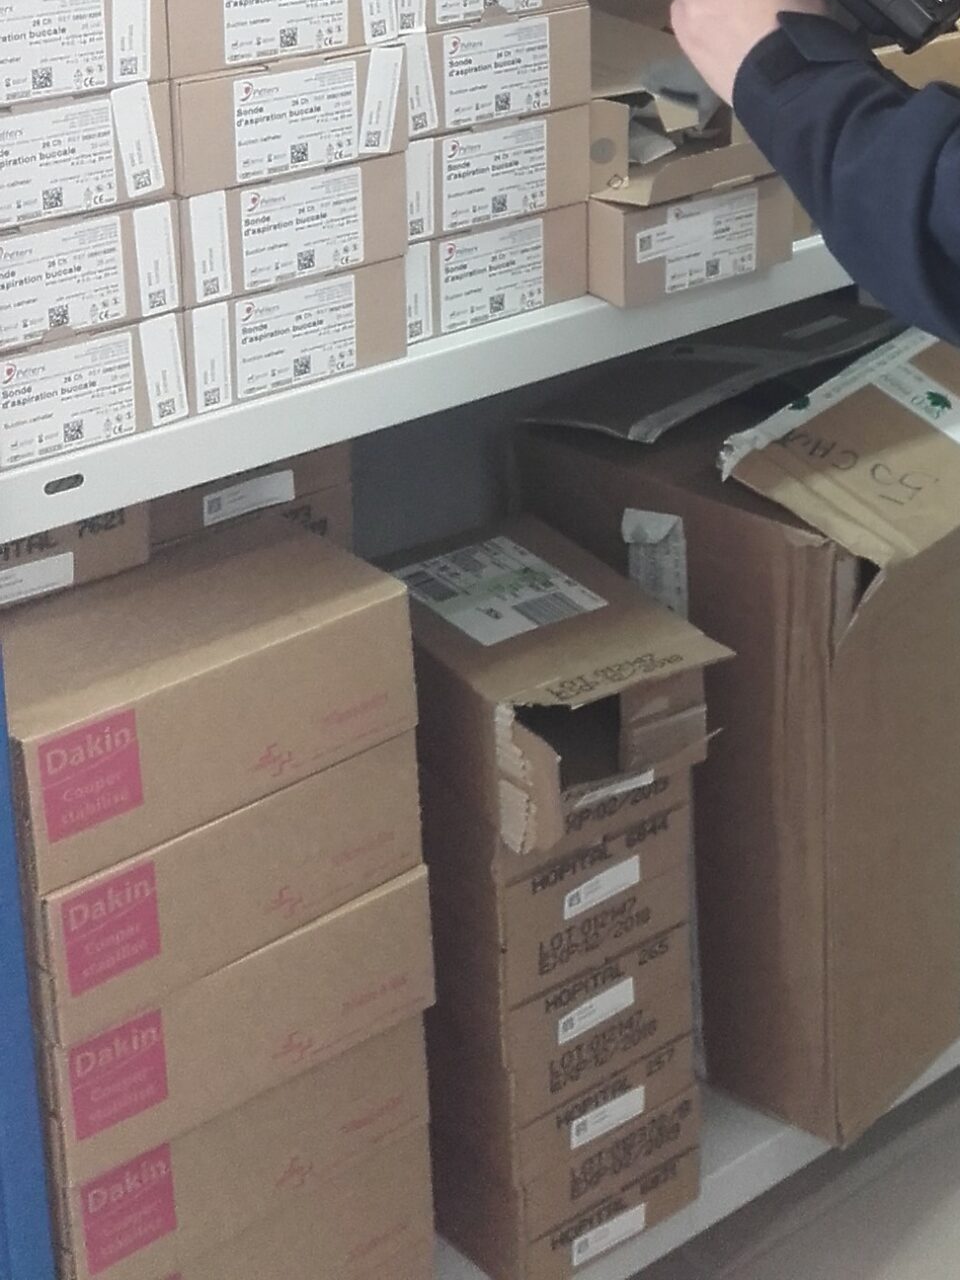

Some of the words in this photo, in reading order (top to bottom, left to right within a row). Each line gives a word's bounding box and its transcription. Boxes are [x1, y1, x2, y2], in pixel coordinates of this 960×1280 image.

[29, 27, 66, 39] buccale
[236, 106, 264, 117] Sonde
[236, 112, 287, 127] d'aspiration
[289, 106, 321, 117] buccale
[39, 147, 76, 160] buccale
[244, 216, 271, 227] Sonde
[295, 213, 327, 224] buccale
[45, 265, 82, 279] buccale
[2, 386, 32, 399] Sonde
[2, 390, 58, 409] d'aspiration
[61, 381, 97, 395] buccale
[46, 726, 131, 775] Dakin
[69, 880, 152, 932] Dakin
[545, 966, 625, 1013] HOPITAL
[76, 1028, 158, 1079] Dakin
[88, 1160, 167, 1214] Dakin
